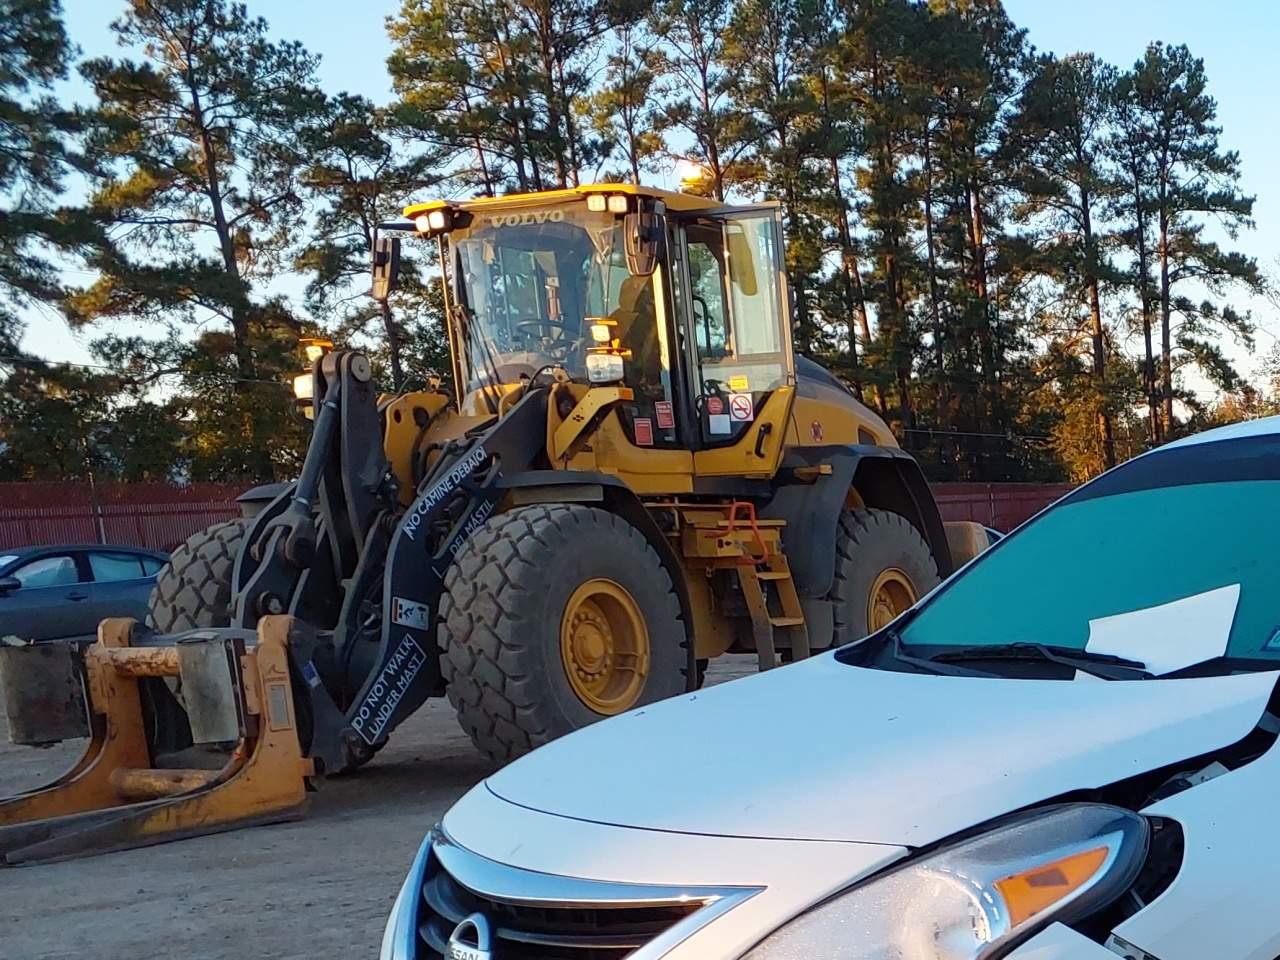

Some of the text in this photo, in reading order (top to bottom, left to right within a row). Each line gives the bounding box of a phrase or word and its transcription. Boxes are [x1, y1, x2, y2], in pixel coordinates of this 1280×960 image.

[490, 210, 565, 229] VOLVO
[404, 447, 487, 537] NO CAMINE DEBAJO
[449, 499, 495, 556] DEL MÁSTIL
[352, 637, 414, 729] DO NOT WALK
[368, 653, 421, 734] UNDER MAST
